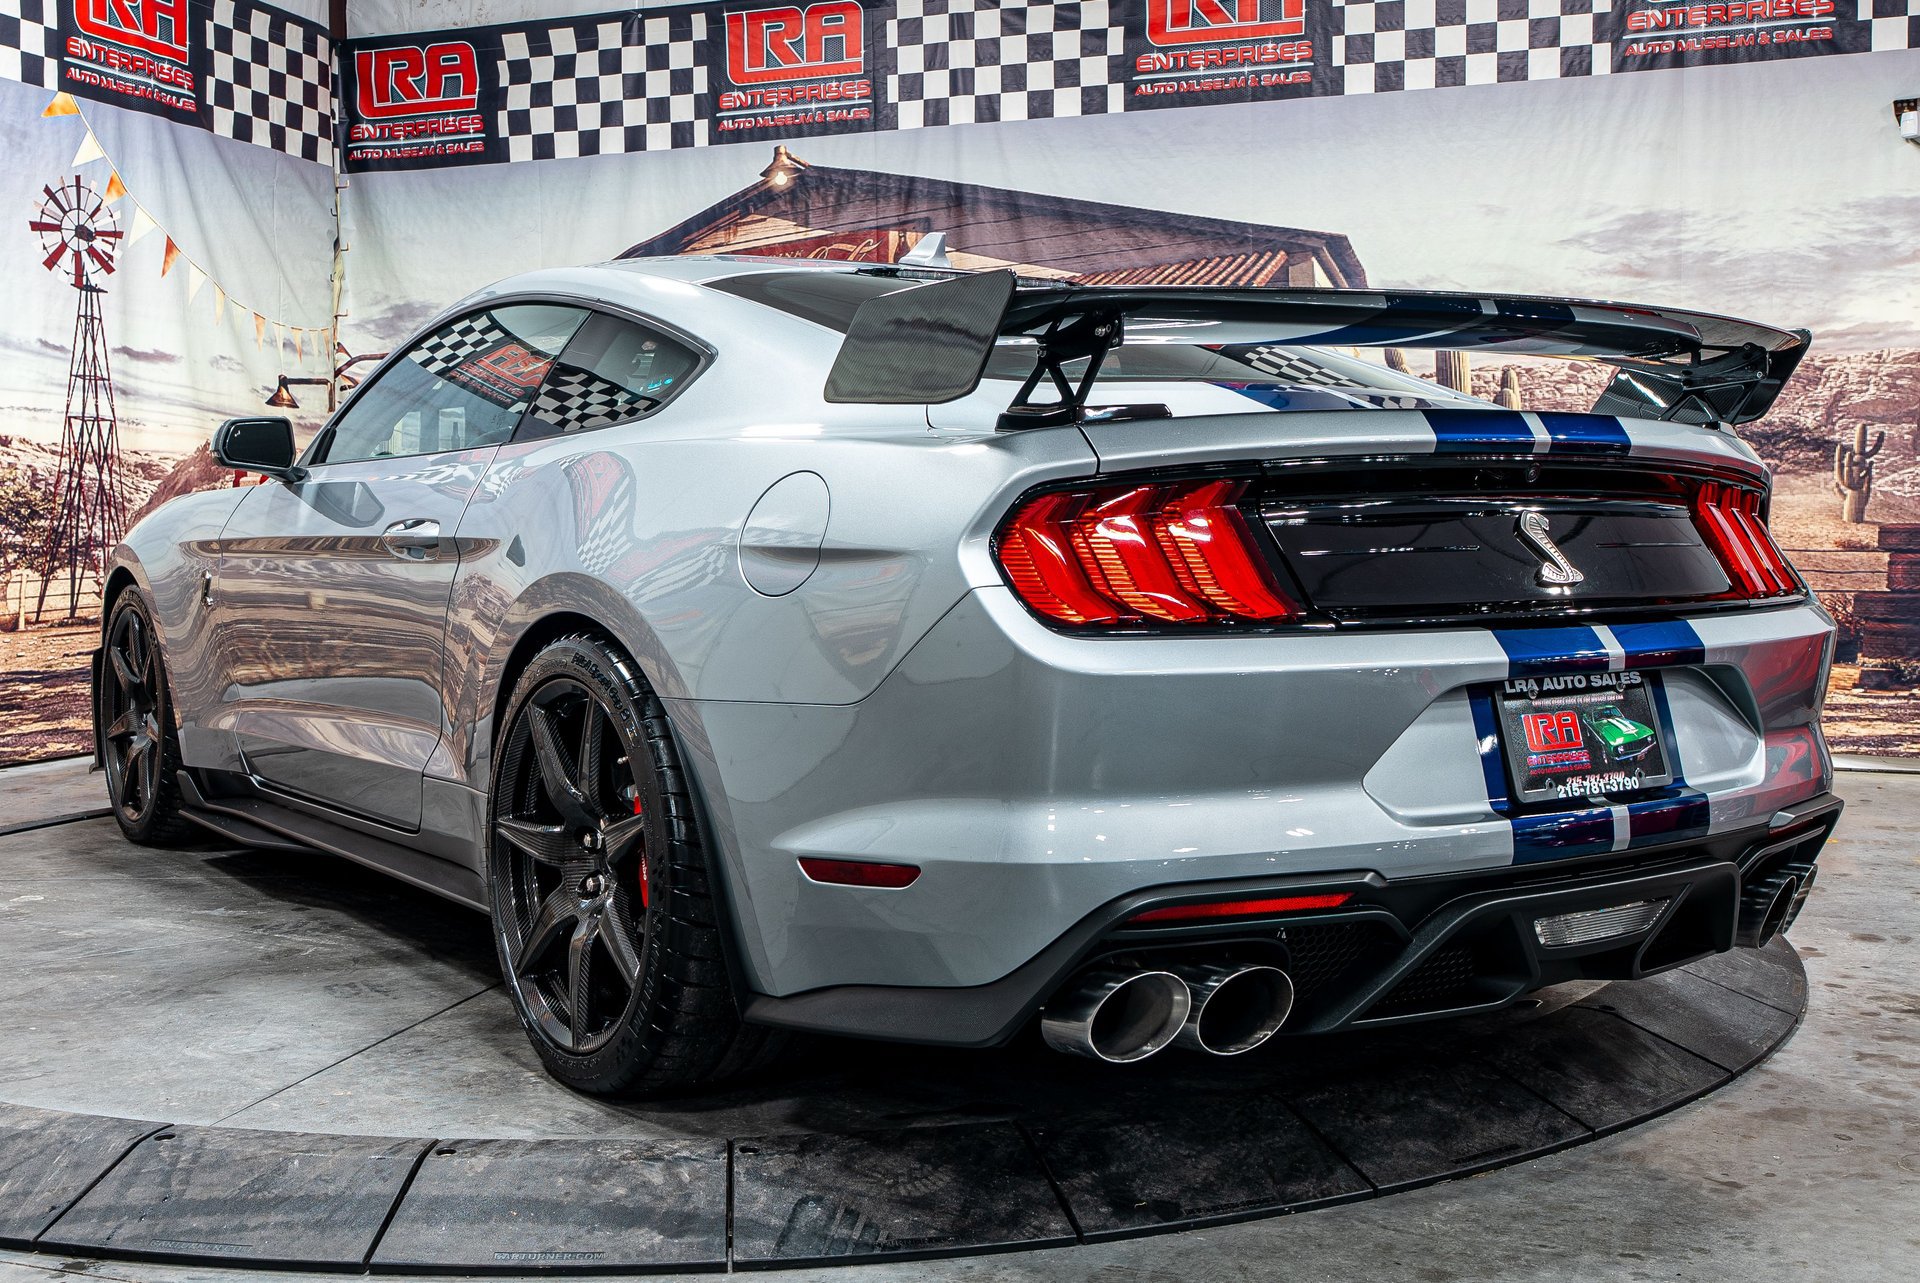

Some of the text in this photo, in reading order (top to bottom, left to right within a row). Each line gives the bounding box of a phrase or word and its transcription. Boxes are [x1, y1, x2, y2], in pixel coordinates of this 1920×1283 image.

[1627, 0, 1835, 31] ENTERPRISES
[724, 0, 864, 86] LRA
[1136, 41, 1313, 72] ENTERPRISES
[1625, 27, 1833, 57] AUTO MUSEUM & SALES
[66, 36, 195, 90] ENTERPRISES
[66, 67, 197, 112] AUTO MUSEUM & SALES
[355, 41, 479, 119] LRA
[719, 79, 871, 109] ENTERPRISES
[1135, 71, 1312, 96] AUTO MUSEUM & SALES
[350, 114, 484, 140] ENTERPRISES
[718, 108, 870, 132] AUTO MUSEUM & SALES
[350, 141, 485, 160] AUTO MUSEUM & SALES
[1504, 679, 1539, 693] LRA
[1543, 675, 1587, 691] AUTO
[1522, 711, 1584, 752] LRA
[1557, 776, 1639, 798] 215-781-3790
